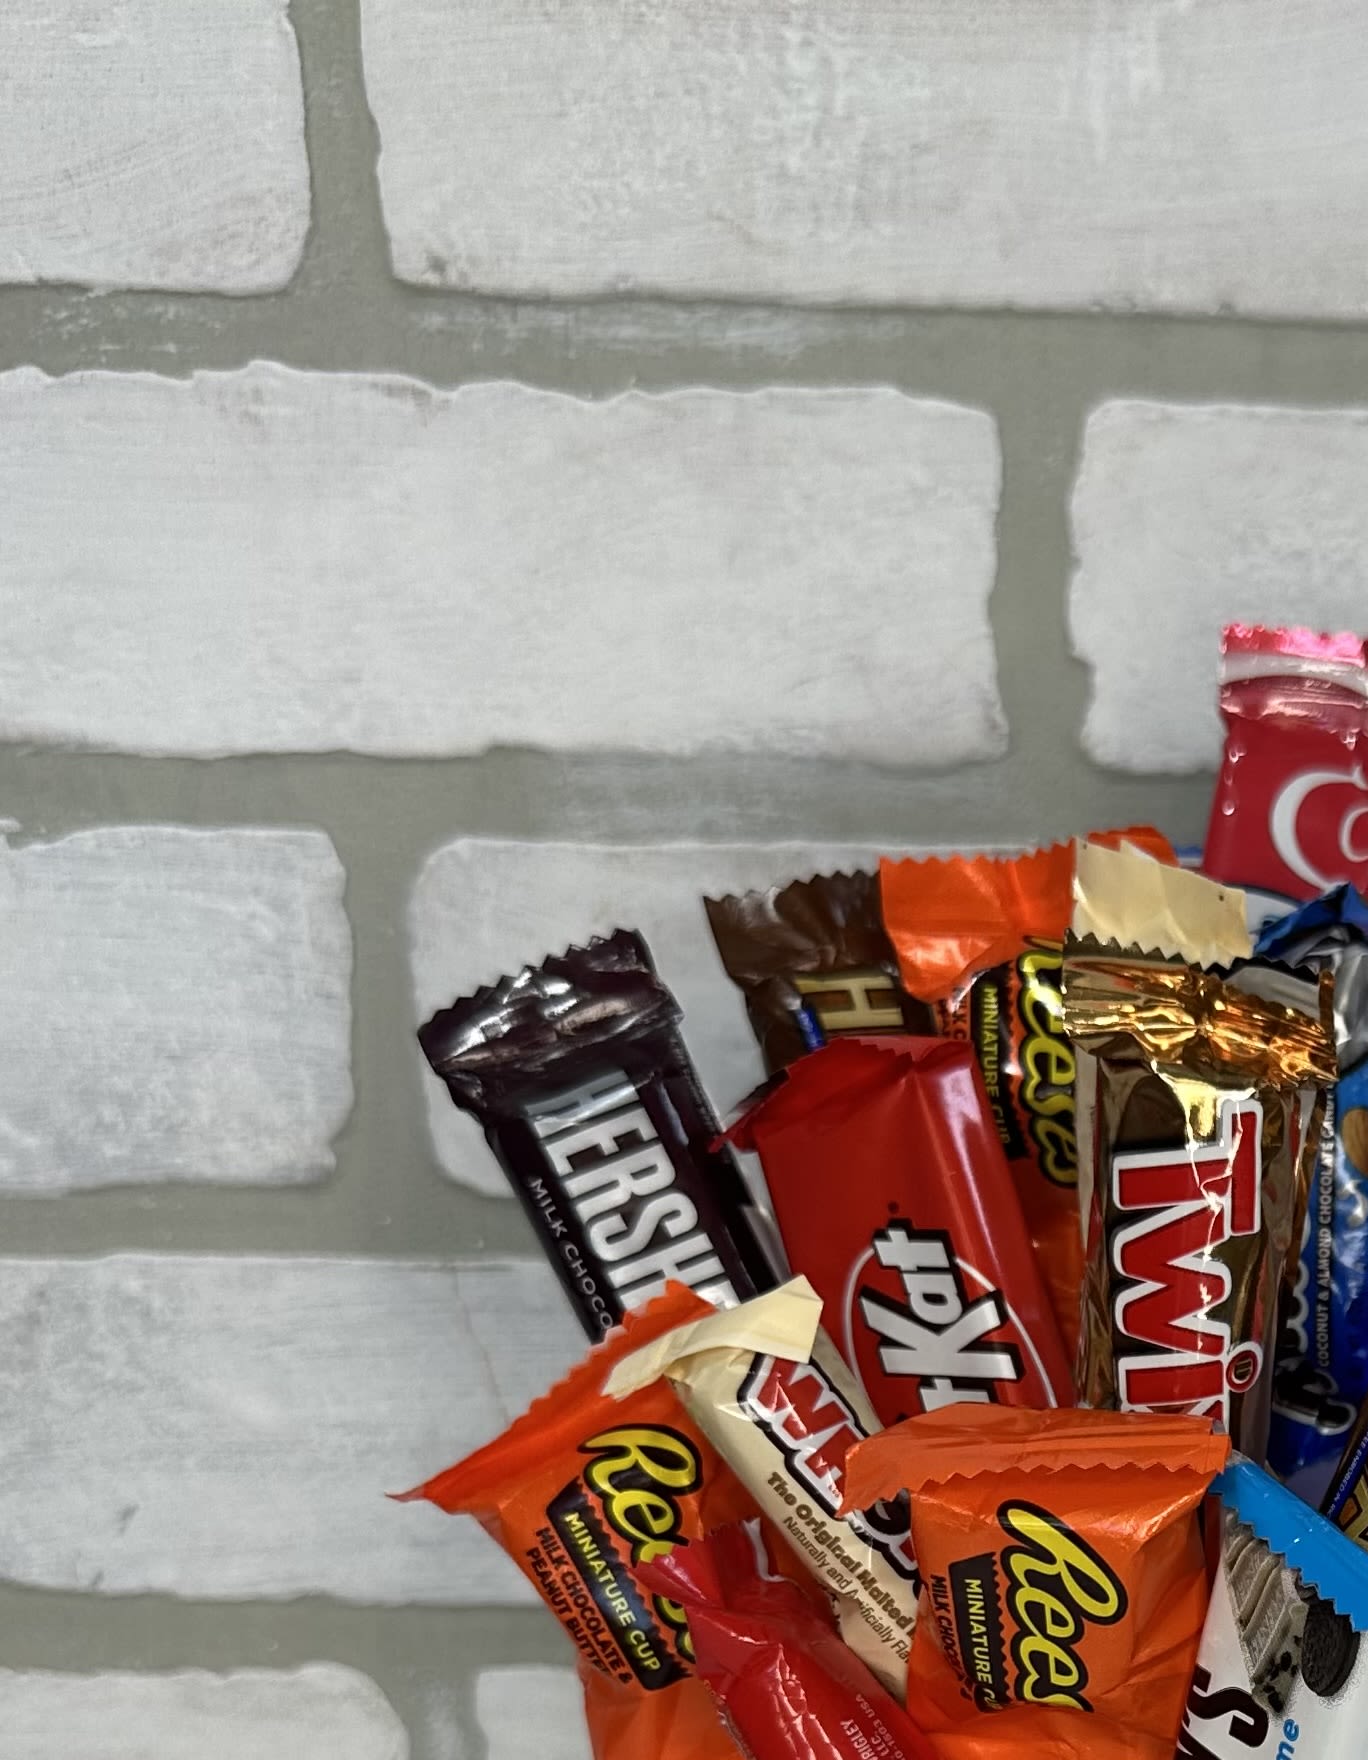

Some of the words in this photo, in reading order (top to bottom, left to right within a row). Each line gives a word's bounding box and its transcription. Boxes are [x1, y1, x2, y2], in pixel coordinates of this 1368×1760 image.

[983, 987, 1000, 1097] MINIATURE
[530, 1176, 567, 1238] MILK
[1320, 1144, 1333, 1223] CHOCOLATE
[1319, 1229, 1331, 1286] ALMOND
[861, 1228, 1016, 1379] Kat
[1319, 1291, 1330, 1300] &
[1318, 1305, 1329, 1366] COCONUT
[1339, 1450, 1362, 1492] ENROBED
[525, 1547, 571, 1617] PEANUT
[765, 1471, 799, 1507] The
[794, 1502, 862, 1574] Original
[855, 1568, 914, 1629] Malted
[783, 1516, 834, 1569] Naturally
[826, 1565, 852, 1591] and
[535, 1527, 569, 1570] MILK
[559, 1568, 626, 1672] CHOCOLATE
[618, 1669, 634, 1686] &
[563, 1509, 637, 1628] MINIATURE
[627, 1627, 662, 1675] CUP
[930, 1575, 949, 1611] MILK
[964, 1578, 993, 1686] MINIATURE
[854, 1692, 876, 1718] USA
